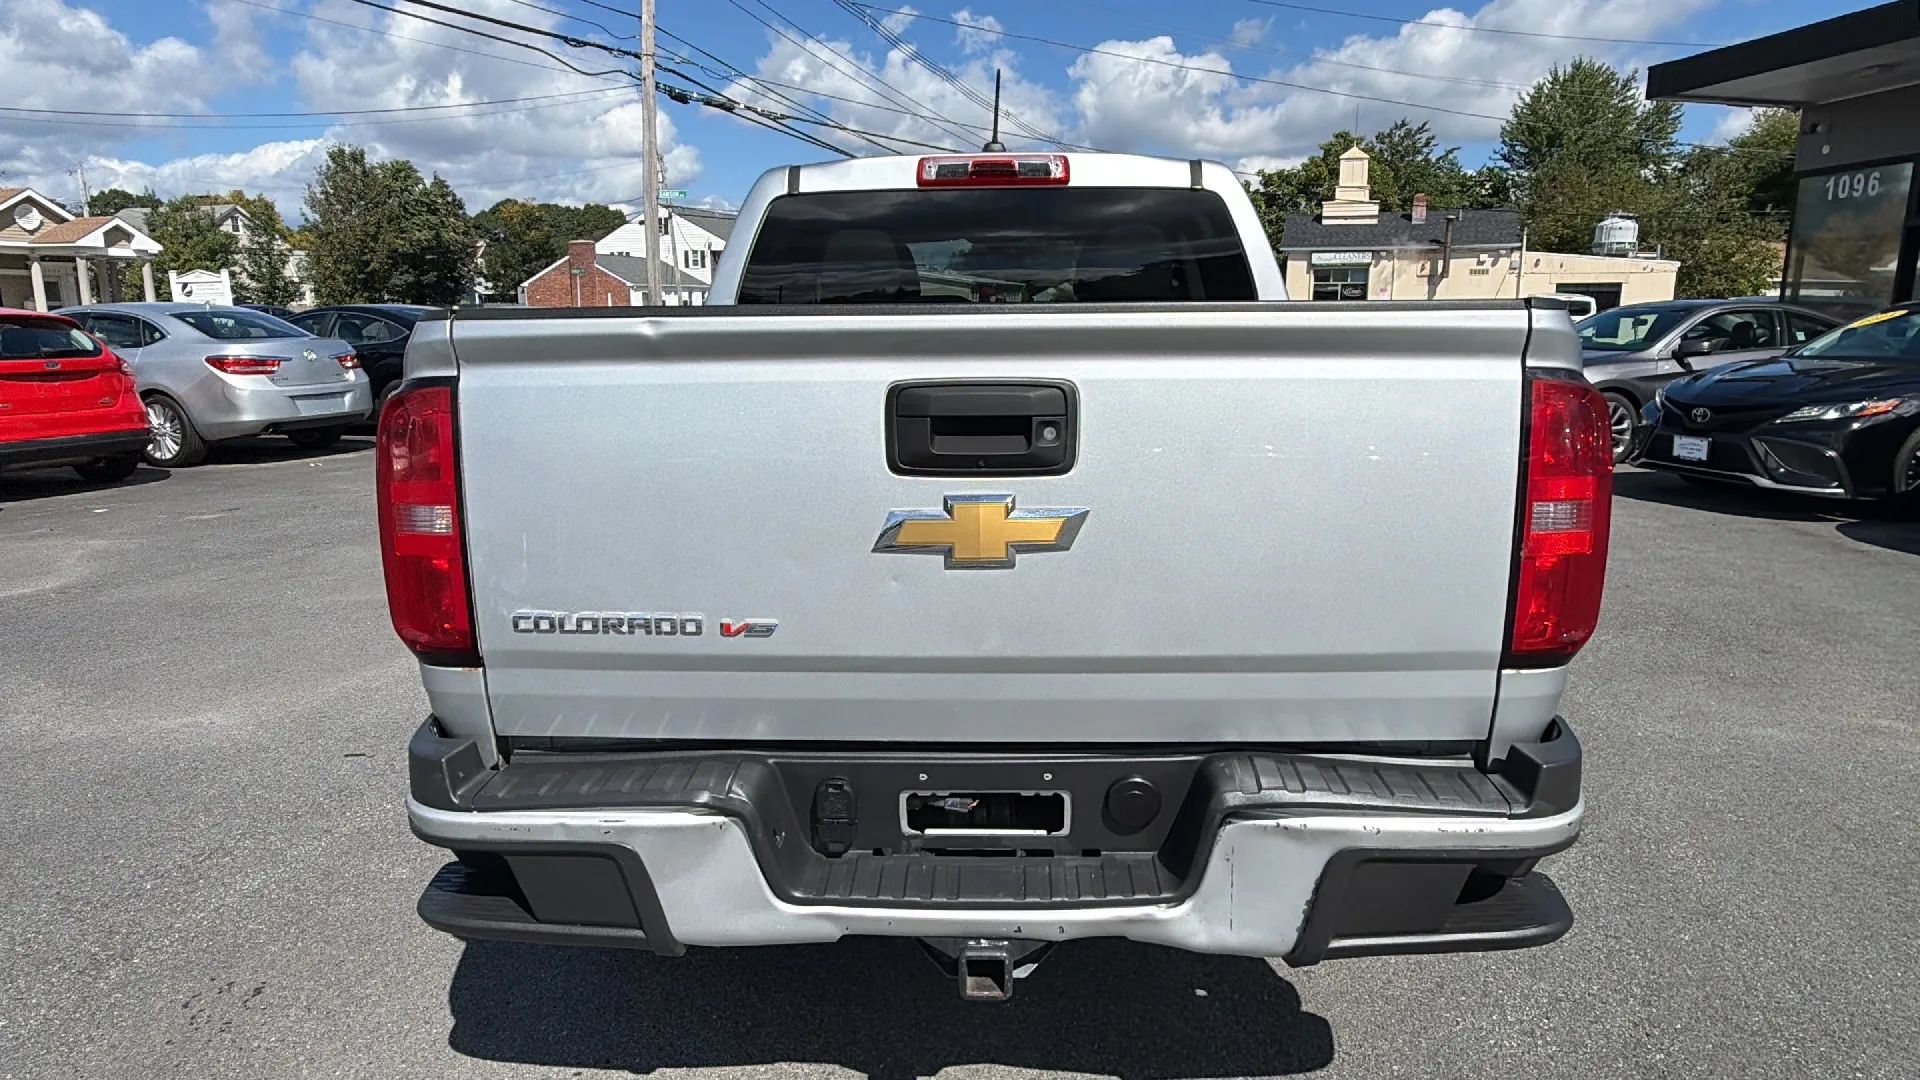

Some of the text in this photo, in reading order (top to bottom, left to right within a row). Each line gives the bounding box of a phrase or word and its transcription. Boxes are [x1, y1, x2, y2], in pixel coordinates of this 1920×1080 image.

[1825, 171, 1881, 201] 1096
[1333, 251, 1371, 261] CLEANERS
[512, 609, 704, 637] COLORADO
